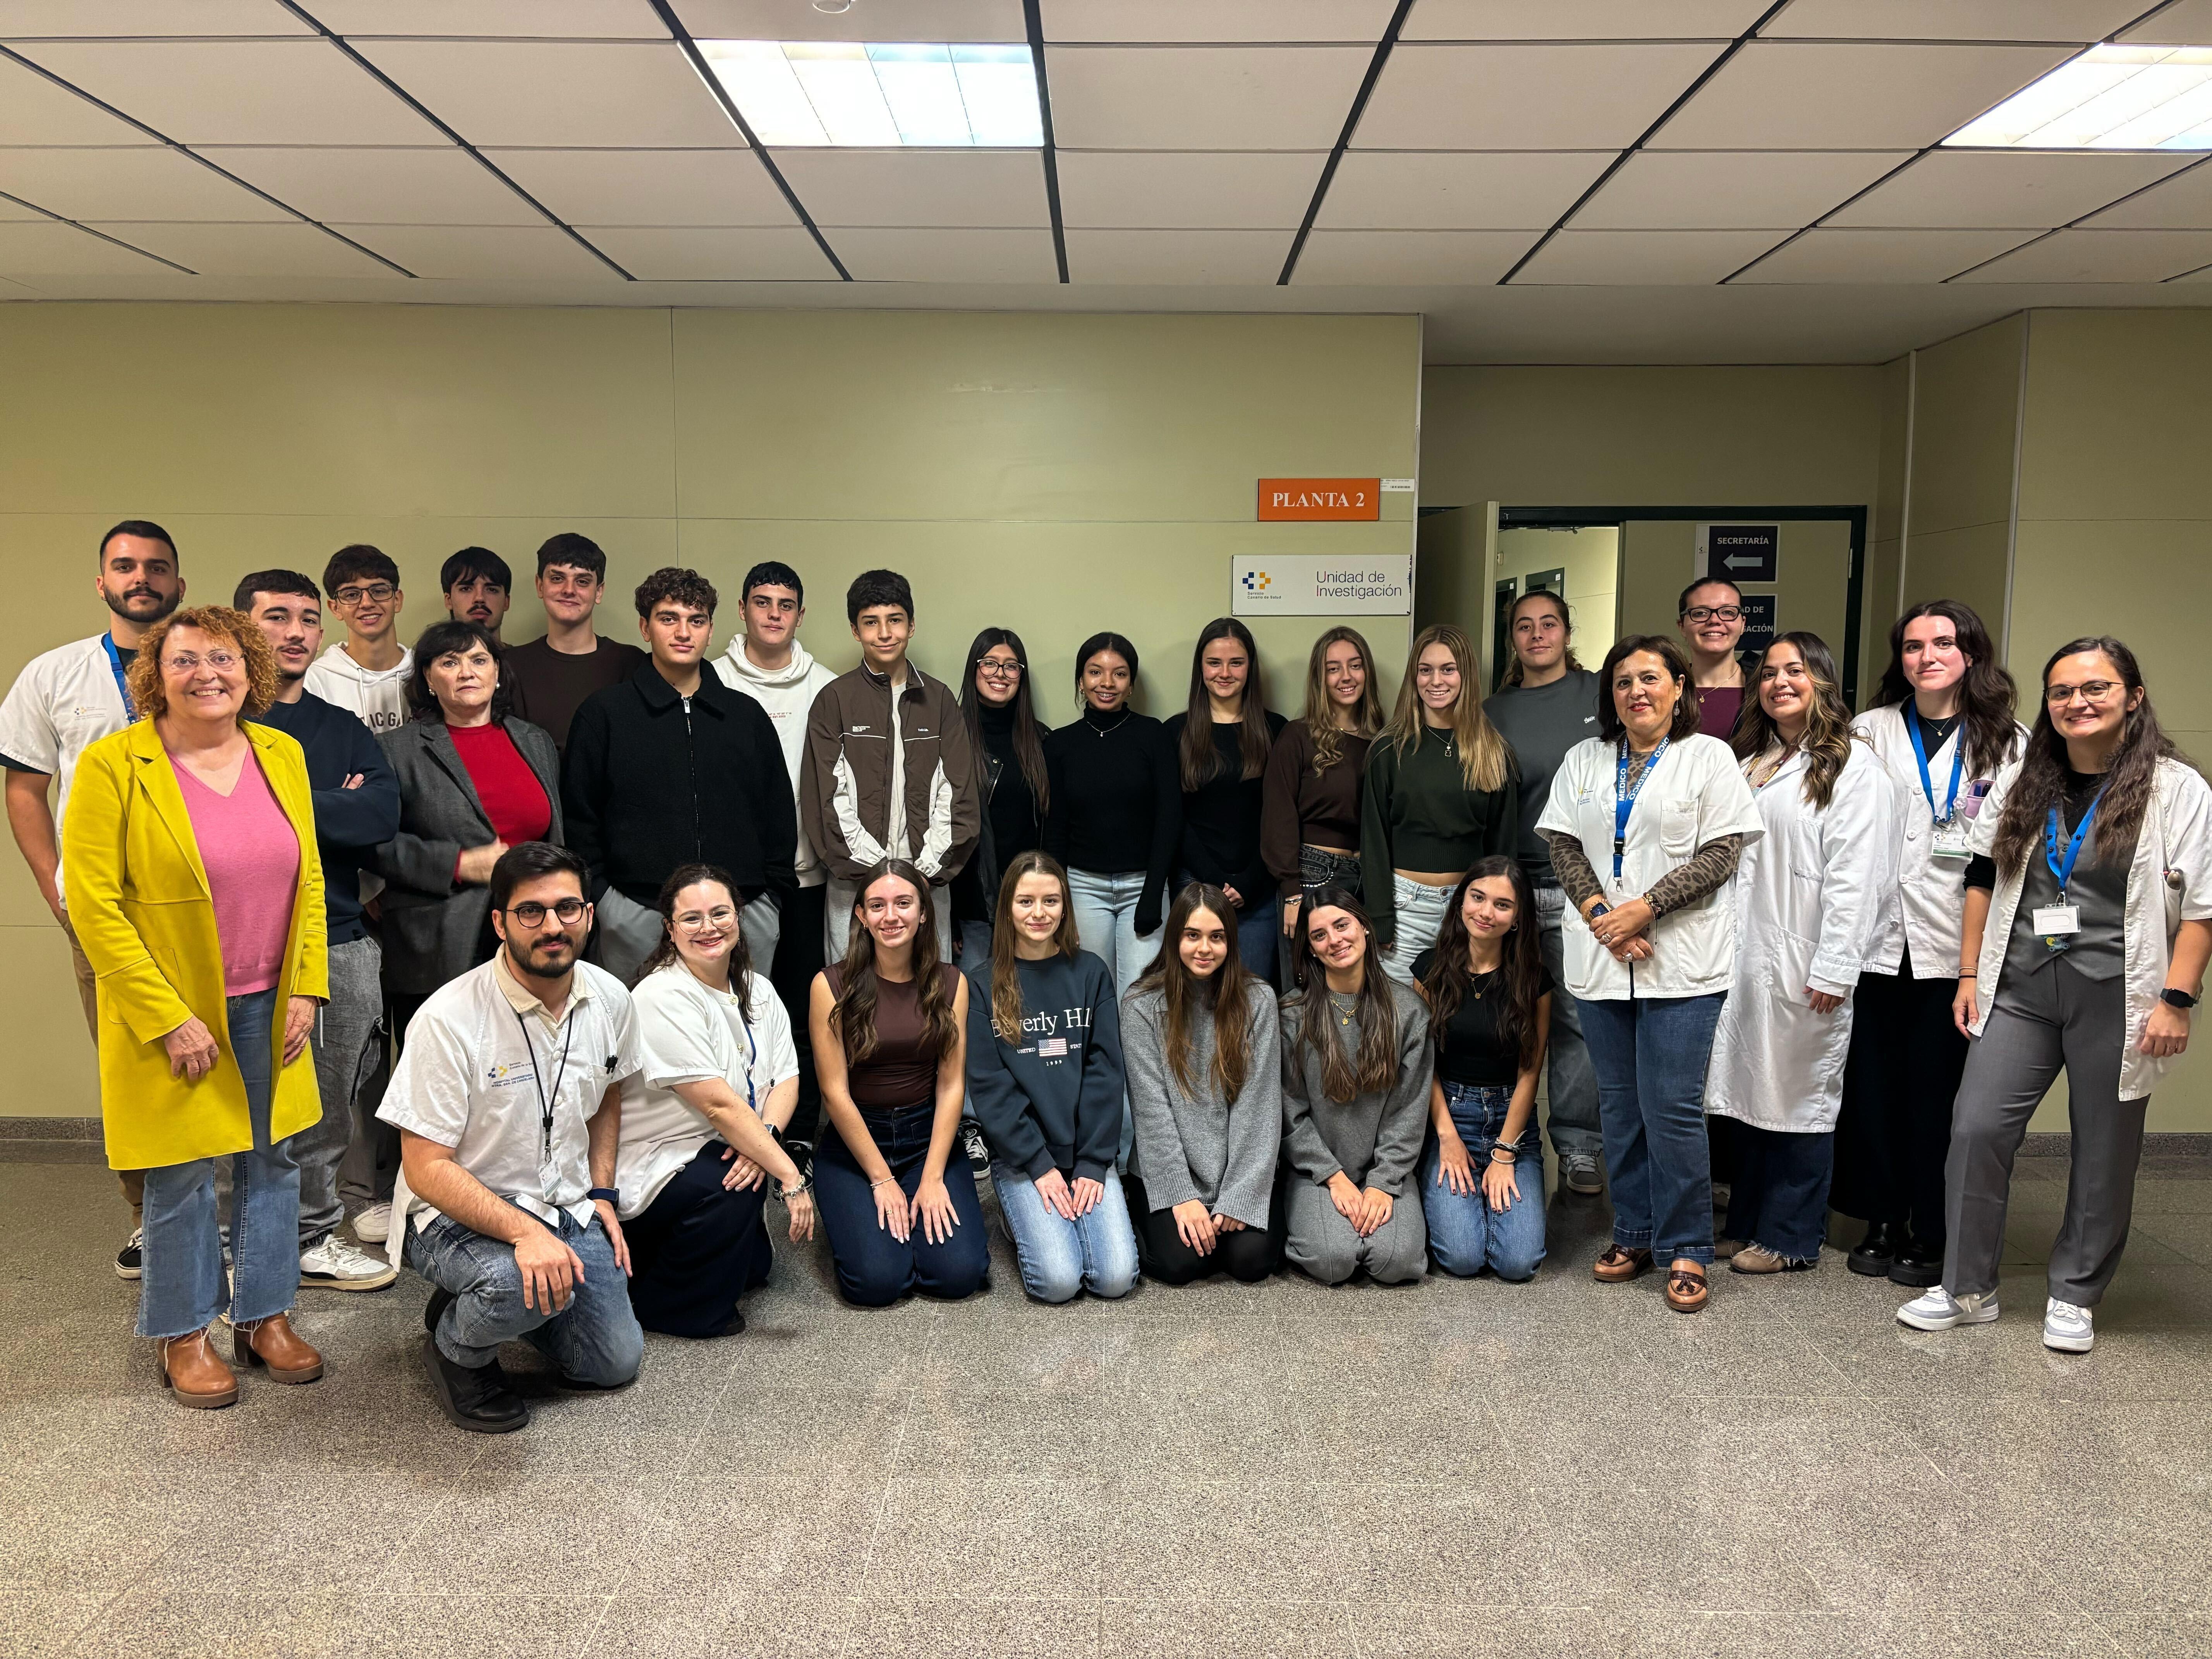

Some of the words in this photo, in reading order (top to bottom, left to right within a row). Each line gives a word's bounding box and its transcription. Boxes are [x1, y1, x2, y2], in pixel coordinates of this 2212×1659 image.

[1272, 492, 1350, 507] PLANTA
[1355, 492, 1365, 507] 2
[1717, 535, 1769, 544] SECRETARÍA
[1317, 570, 1363, 583] Unidad
[1368, 570, 1385, 582] de
[1316, 584, 1401, 599] Investigación
[1654, 735, 1669, 758] DICO
[1618, 768, 1626, 802] MEDICO
[1629, 766, 1652, 800] MEDICO
